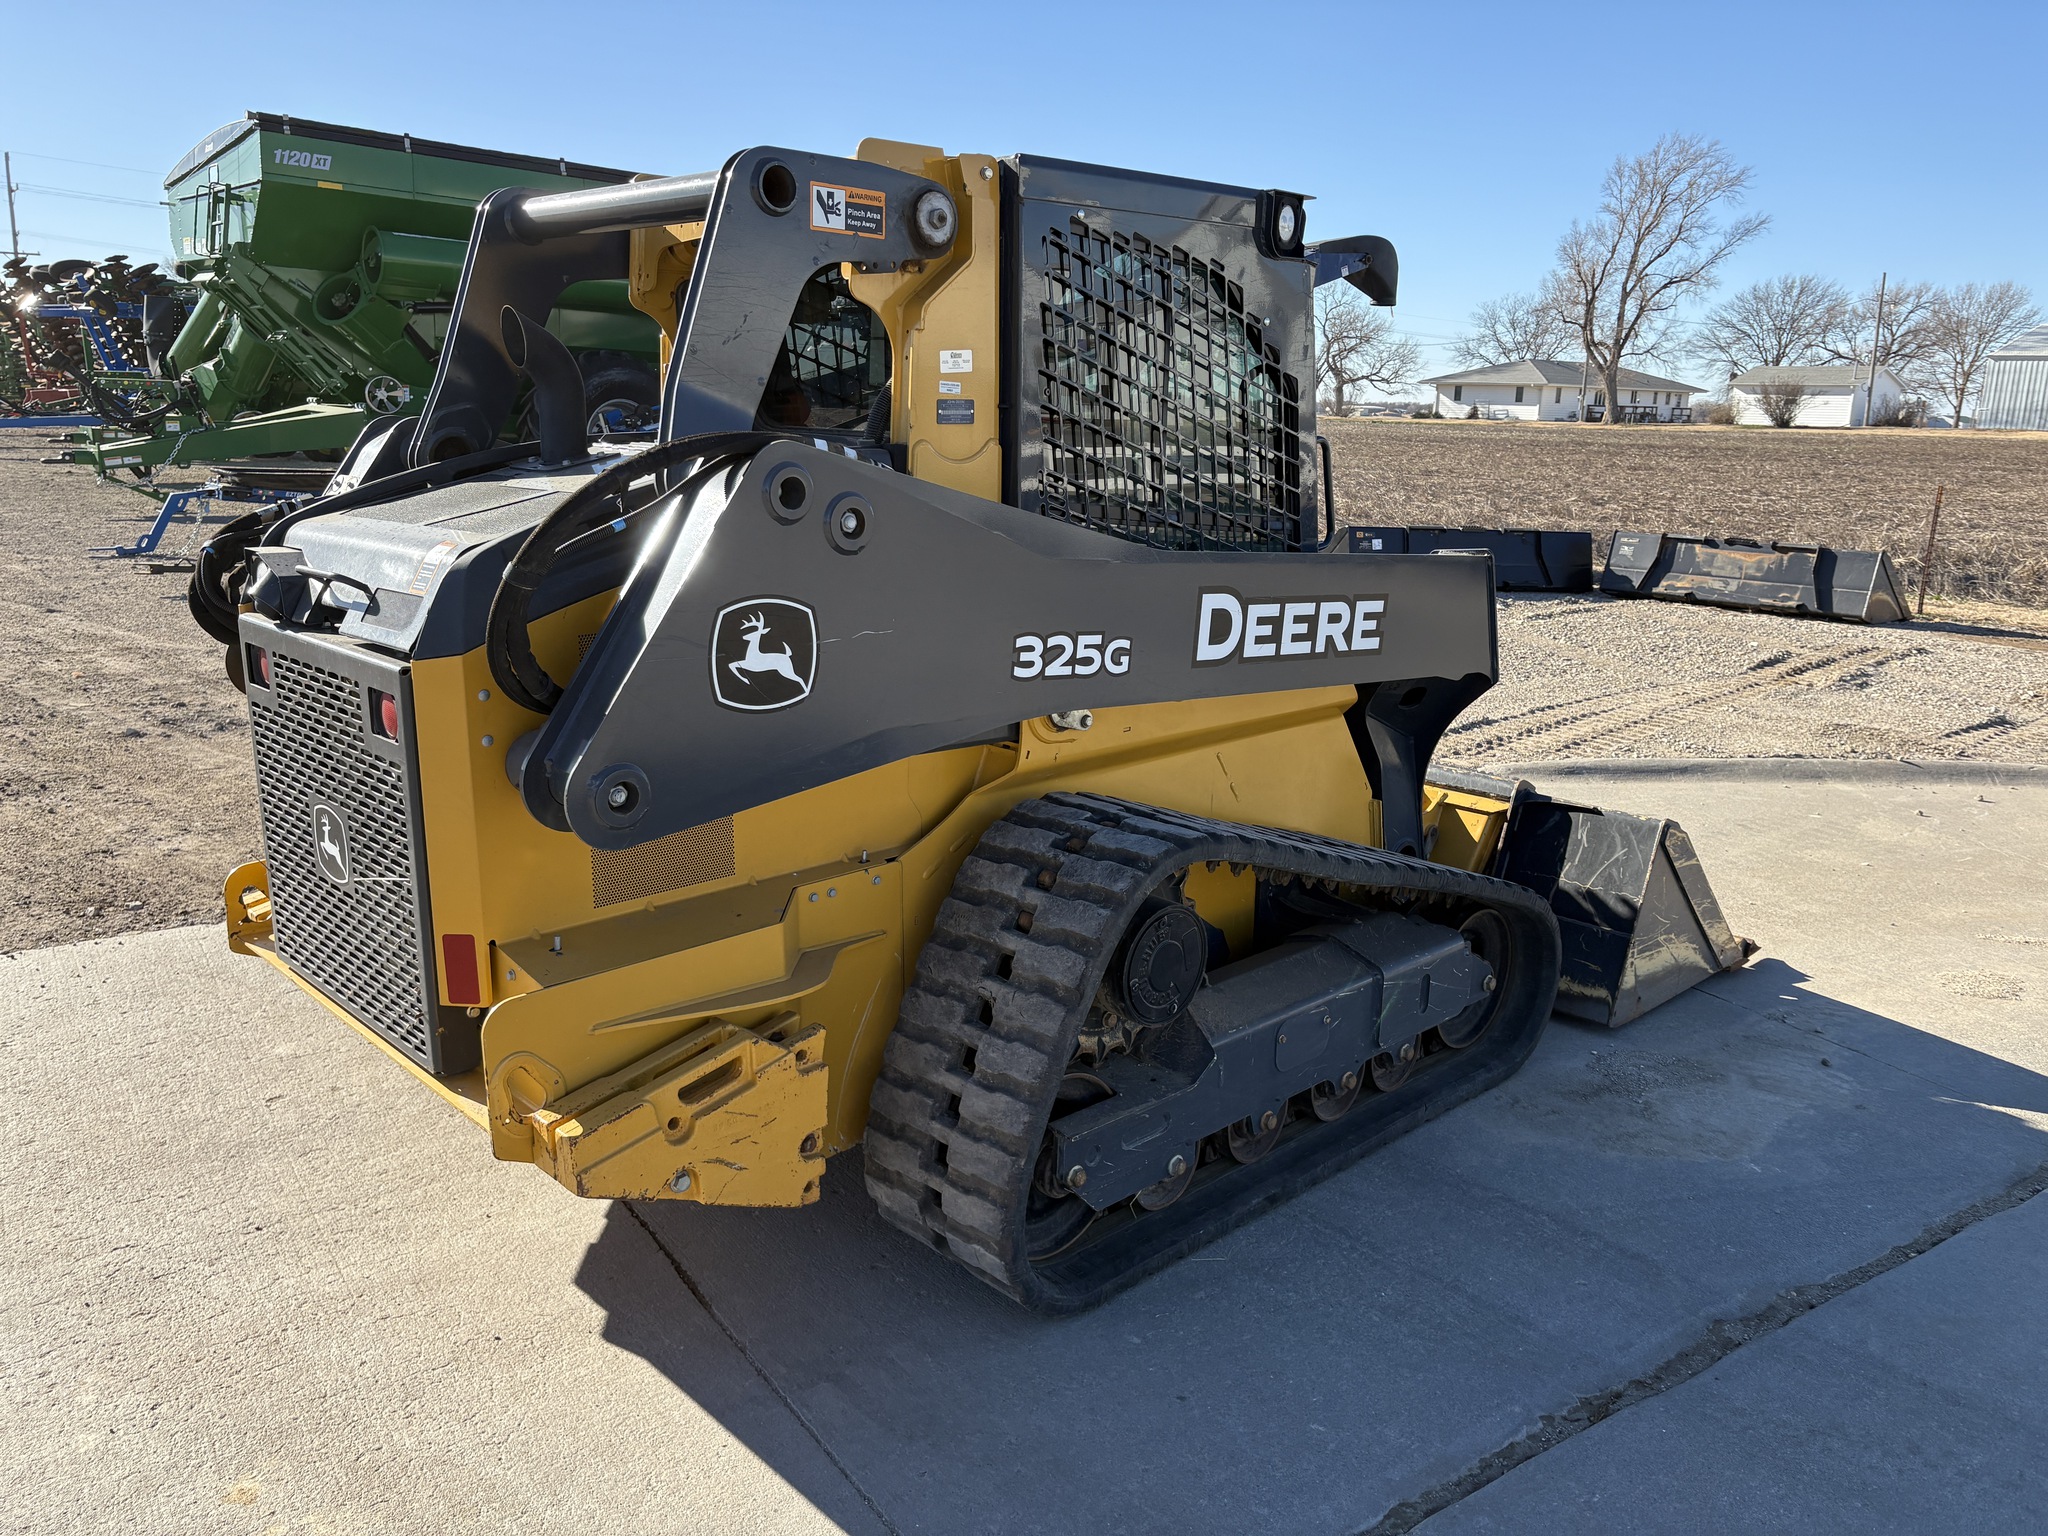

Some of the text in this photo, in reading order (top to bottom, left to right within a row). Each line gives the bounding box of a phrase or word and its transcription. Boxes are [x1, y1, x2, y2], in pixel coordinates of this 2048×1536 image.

[855, 192, 882, 203] WARNING
[847, 208, 881, 220] Pinch Area
[847, 218, 877, 230] Keep Away
[1196, 593, 1385, 661] DEERE
[1013, 635, 1131, 678] 325G
